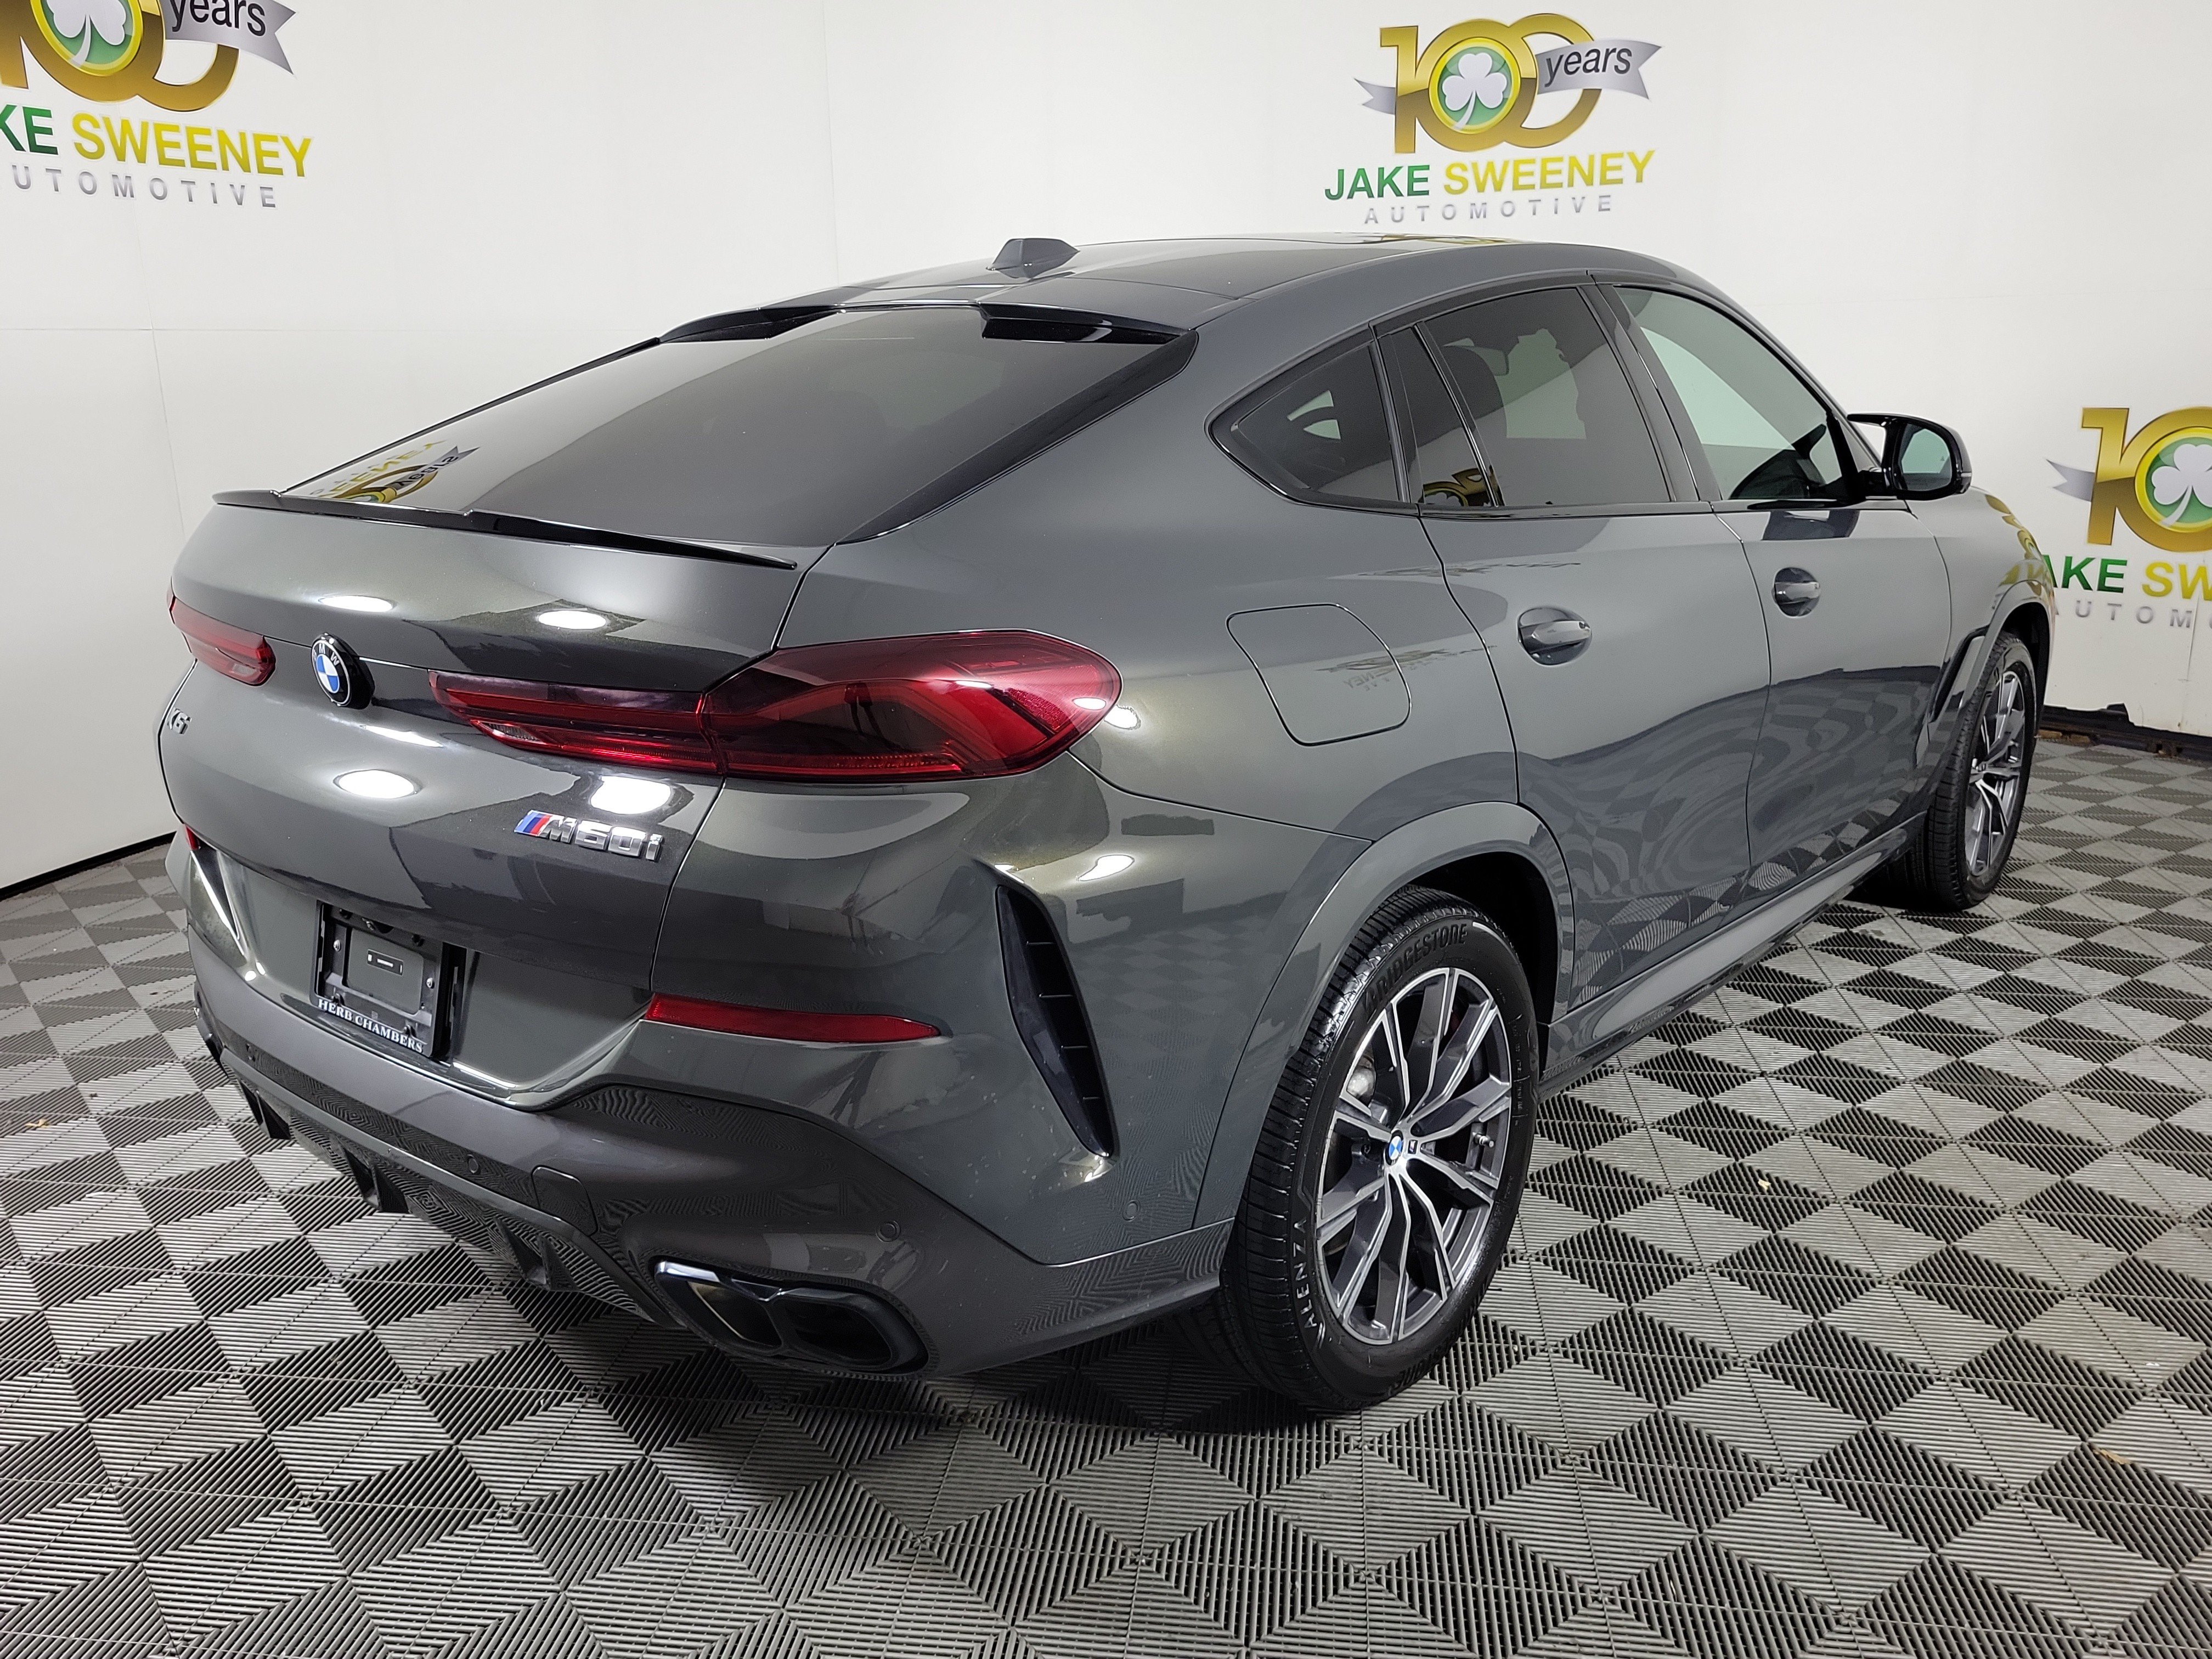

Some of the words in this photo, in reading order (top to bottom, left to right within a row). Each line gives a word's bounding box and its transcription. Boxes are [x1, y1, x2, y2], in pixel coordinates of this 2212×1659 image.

[171, 0, 266, 36] years
[1545, 47, 1633, 87] years
[72, 112, 313, 178] SWEENEY
[1325, 165, 1430, 200] JAKE
[1443, 150, 1656, 195] SWEENEY
[1364, 195, 1612, 224] AUTOMOTIVE
[533, 813, 664, 862] M60i
[318, 998, 353, 1021] HERB
[354, 1015, 423, 1054] CHAMBERS
[1293, 1219, 1317, 1328] ALENZA
